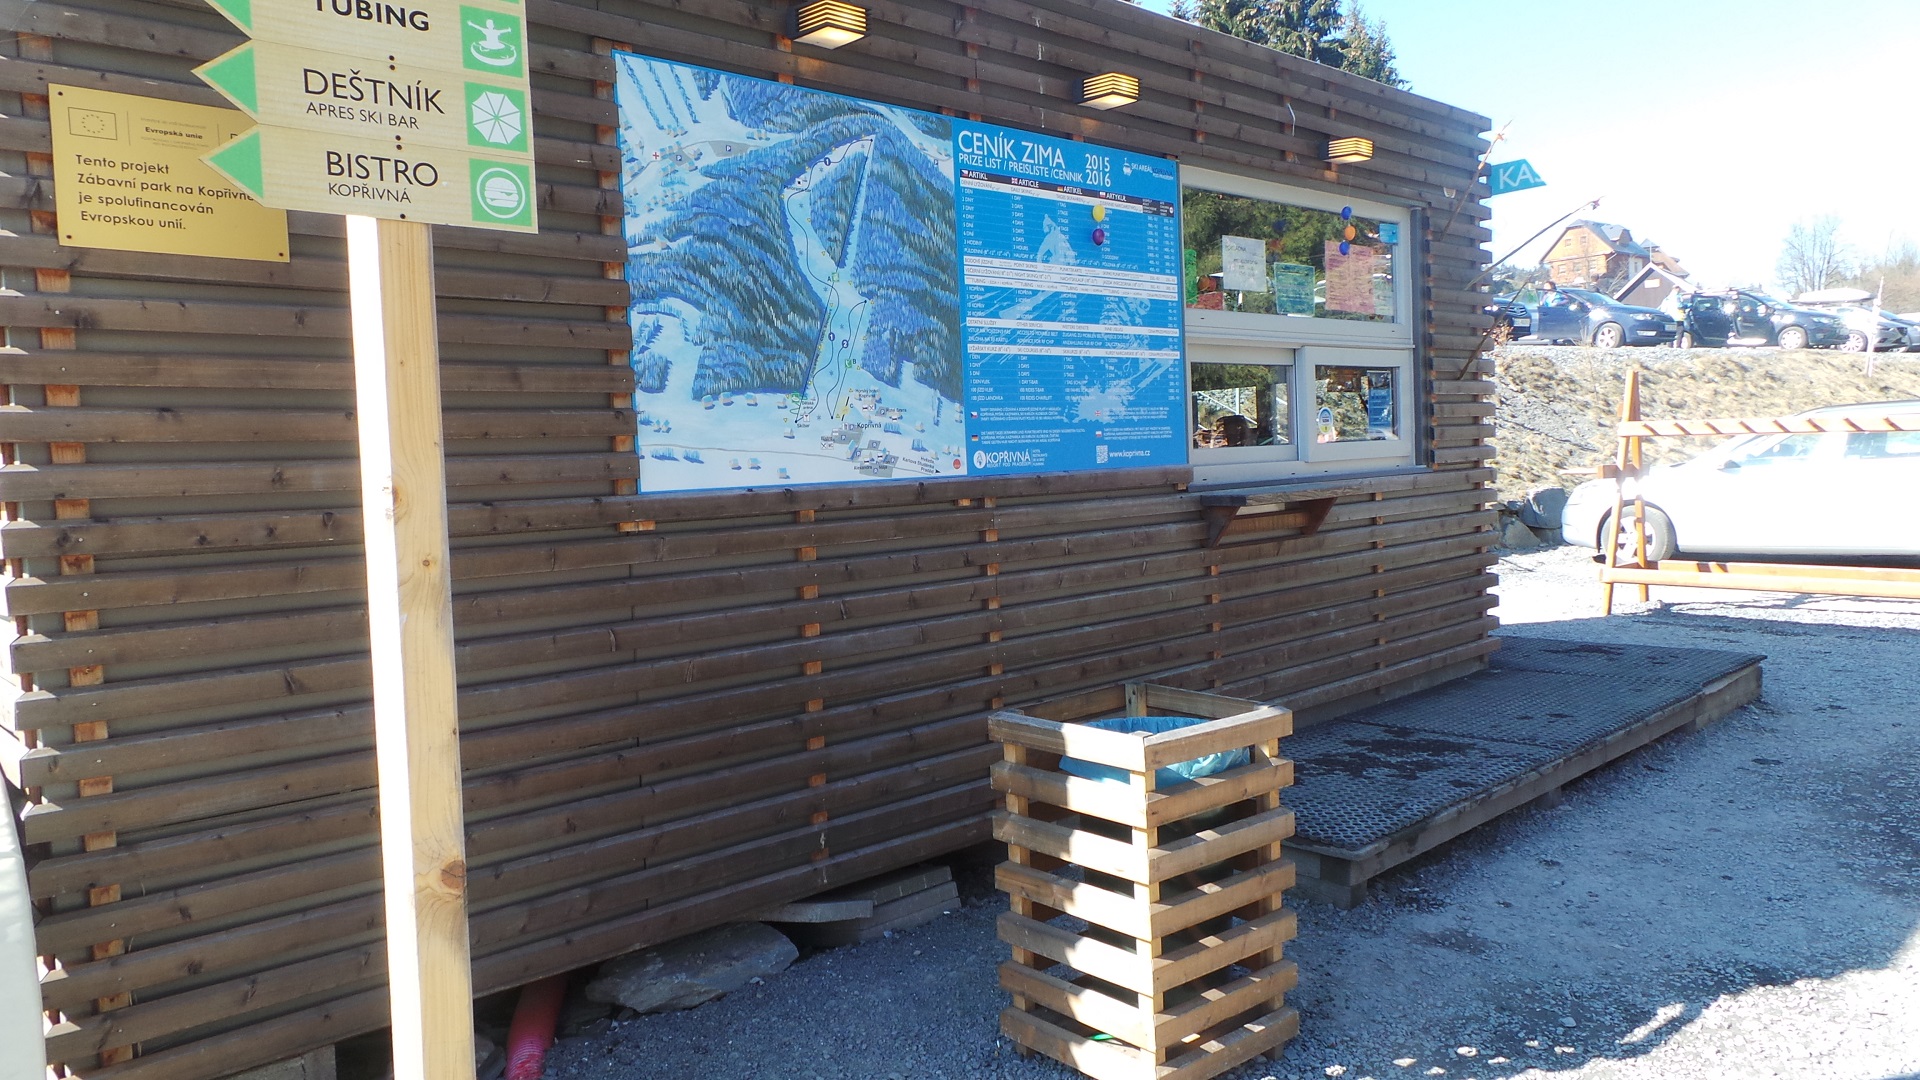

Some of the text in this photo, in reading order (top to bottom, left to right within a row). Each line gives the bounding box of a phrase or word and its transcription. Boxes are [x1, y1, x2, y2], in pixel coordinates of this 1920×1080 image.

[303, 68, 446, 115] DEŠTNÍK
[306, 102, 420, 130] APRES SKI BAR
[185, 133, 204, 141] unie
[958, 130, 1066, 168] CENÍK ZIMA
[75, 154, 170, 175] Tento projekt
[326, 150, 439, 187] BISTRO
[959, 153, 982, 166] PRIZE
[985, 157, 1001, 169] LIST
[1009, 161, 1049, 177] PREISLISTE
[1085, 153, 1110, 172] 2015
[77, 173, 136, 189] Zábavní
[140, 180, 172, 192] park
[176, 186, 194, 195] na
[968, 170, 987, 180] ARTIKL
[1018, 178, 1039, 188] ARTICLE
[1086, 169, 1111, 187] 2016
[328, 182, 412, 204] KOPŘIVNÁ
[1064, 186, 1082, 195] ARTIKEL
[78, 191, 214, 214] je spolufinancován
[81, 210, 187, 230] Evropskou unií.
[986, 449, 1030, 463] KOPŘIVNÁ
